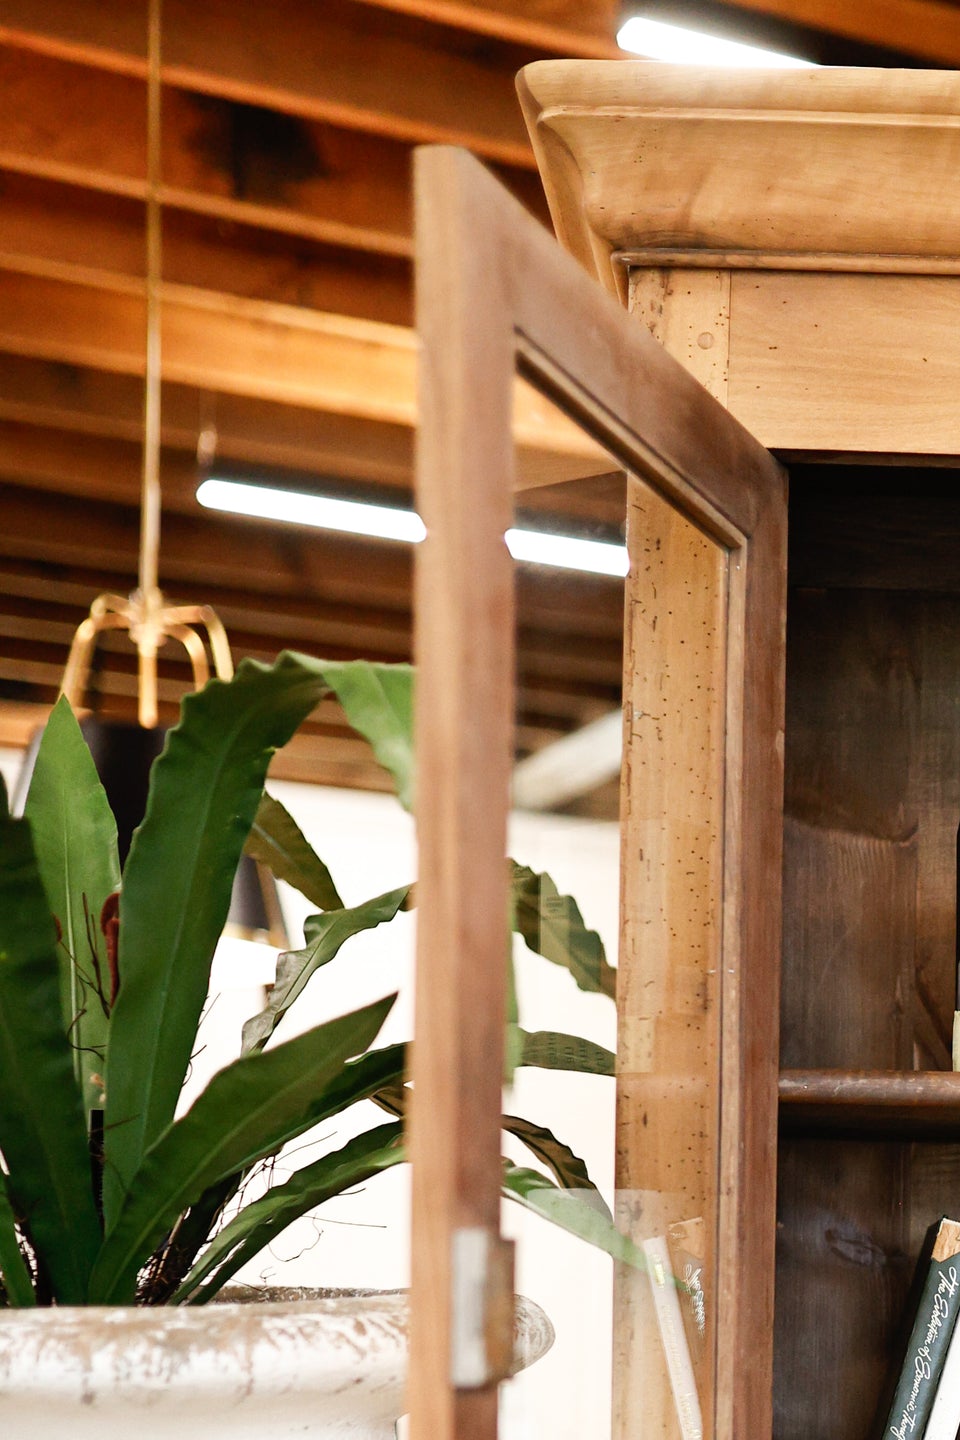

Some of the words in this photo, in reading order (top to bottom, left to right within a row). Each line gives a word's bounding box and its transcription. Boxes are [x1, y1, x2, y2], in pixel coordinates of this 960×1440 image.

[938, 1266, 960, 1298] The
[925, 1293, 949, 1345] Evolution
[917, 1345, 932, 1362] of
[907, 1355, 931, 1412] Economic
